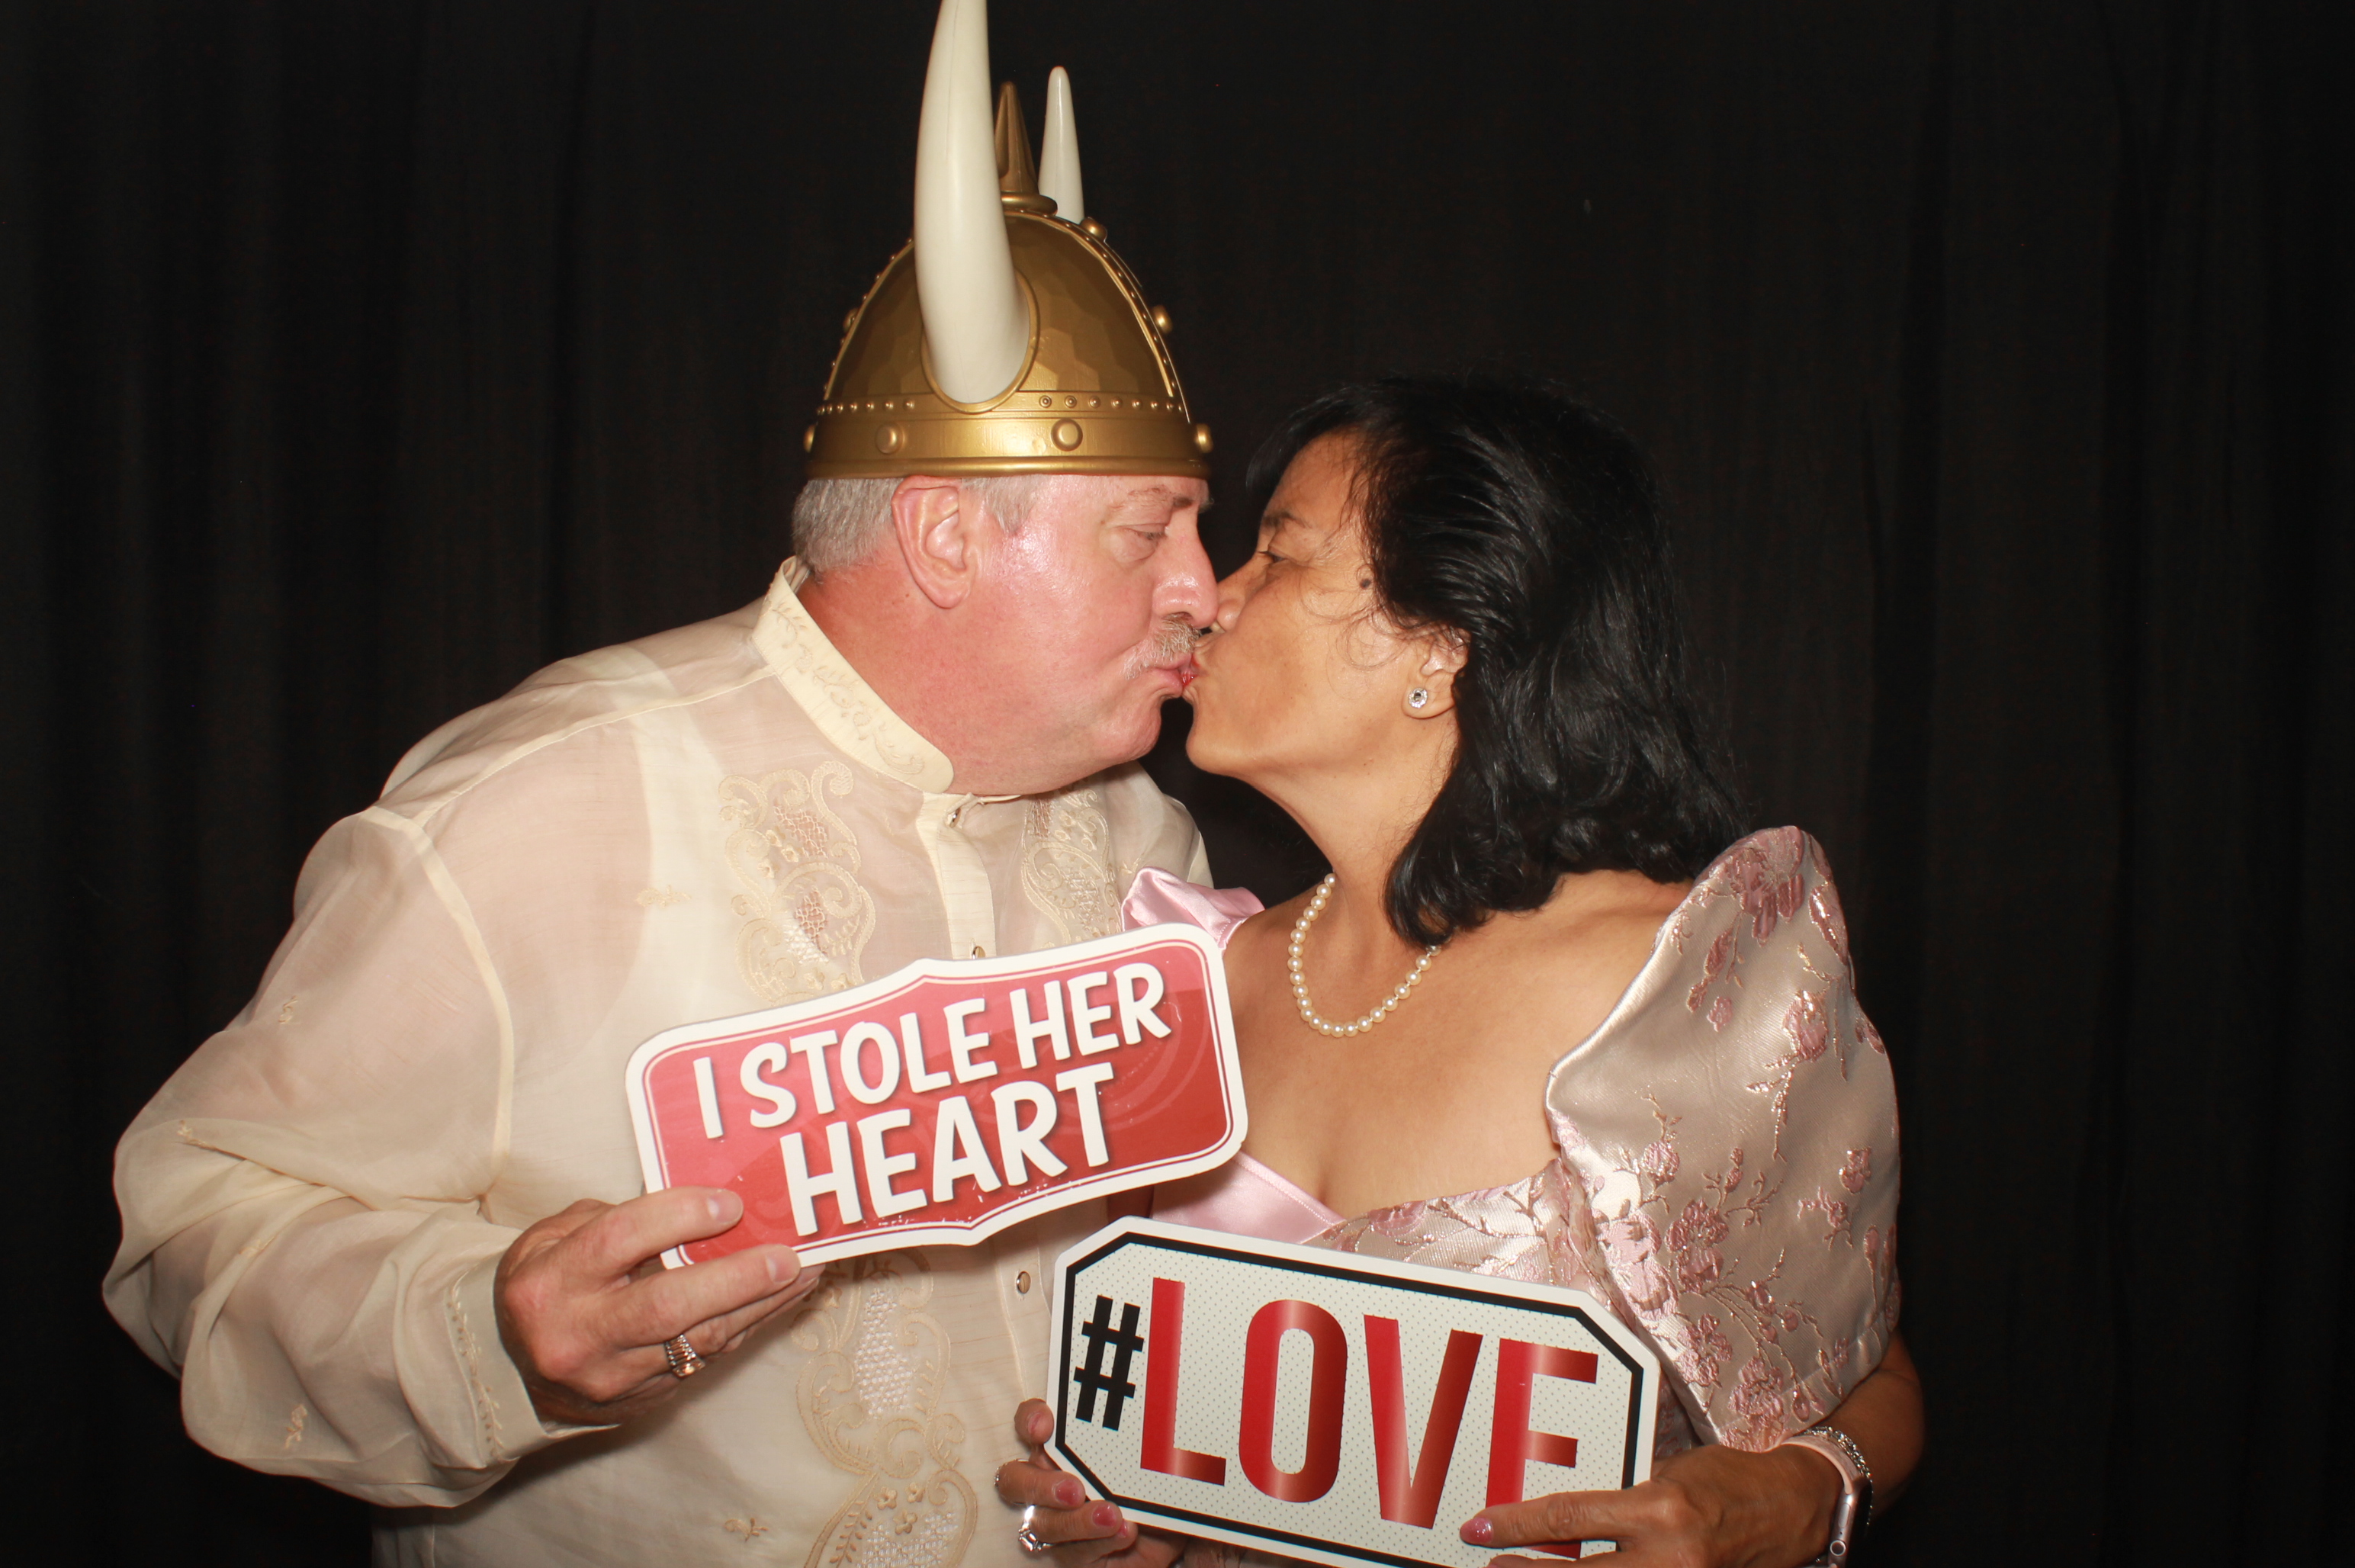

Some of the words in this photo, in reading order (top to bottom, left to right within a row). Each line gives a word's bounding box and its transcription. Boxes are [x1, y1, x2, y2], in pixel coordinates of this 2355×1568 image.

[693, 1056, 724, 1139] I
[739, 998, 998, 1128] STOLE
[1010, 962, 1171, 1068] HER
[779, 1062, 1114, 1236] HEART
